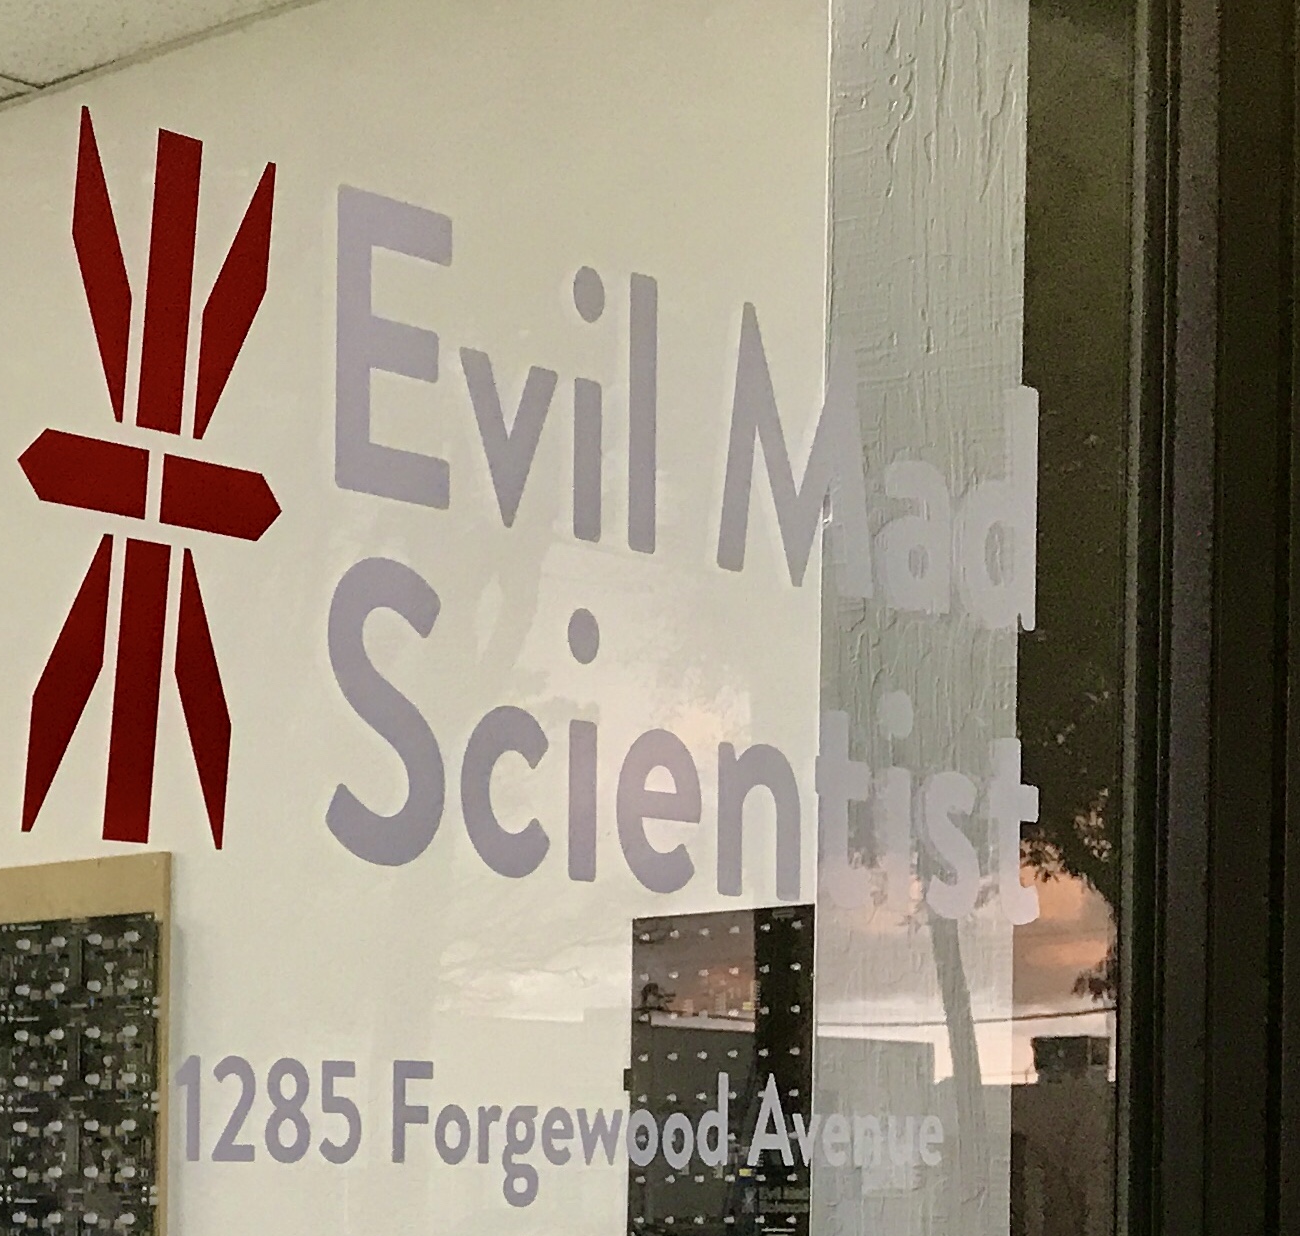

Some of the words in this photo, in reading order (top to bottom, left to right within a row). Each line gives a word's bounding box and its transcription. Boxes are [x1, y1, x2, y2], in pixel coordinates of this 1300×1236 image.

[335, 183, 658, 554] Evil
[716, 301, 1040, 632] Mad
[325, 556, 1040, 925] Scientist
[174, 1056, 361, 1163] 1285
[392, 1060, 727, 1207] Forgewood
[749, 1073, 944, 1168] Avenue
